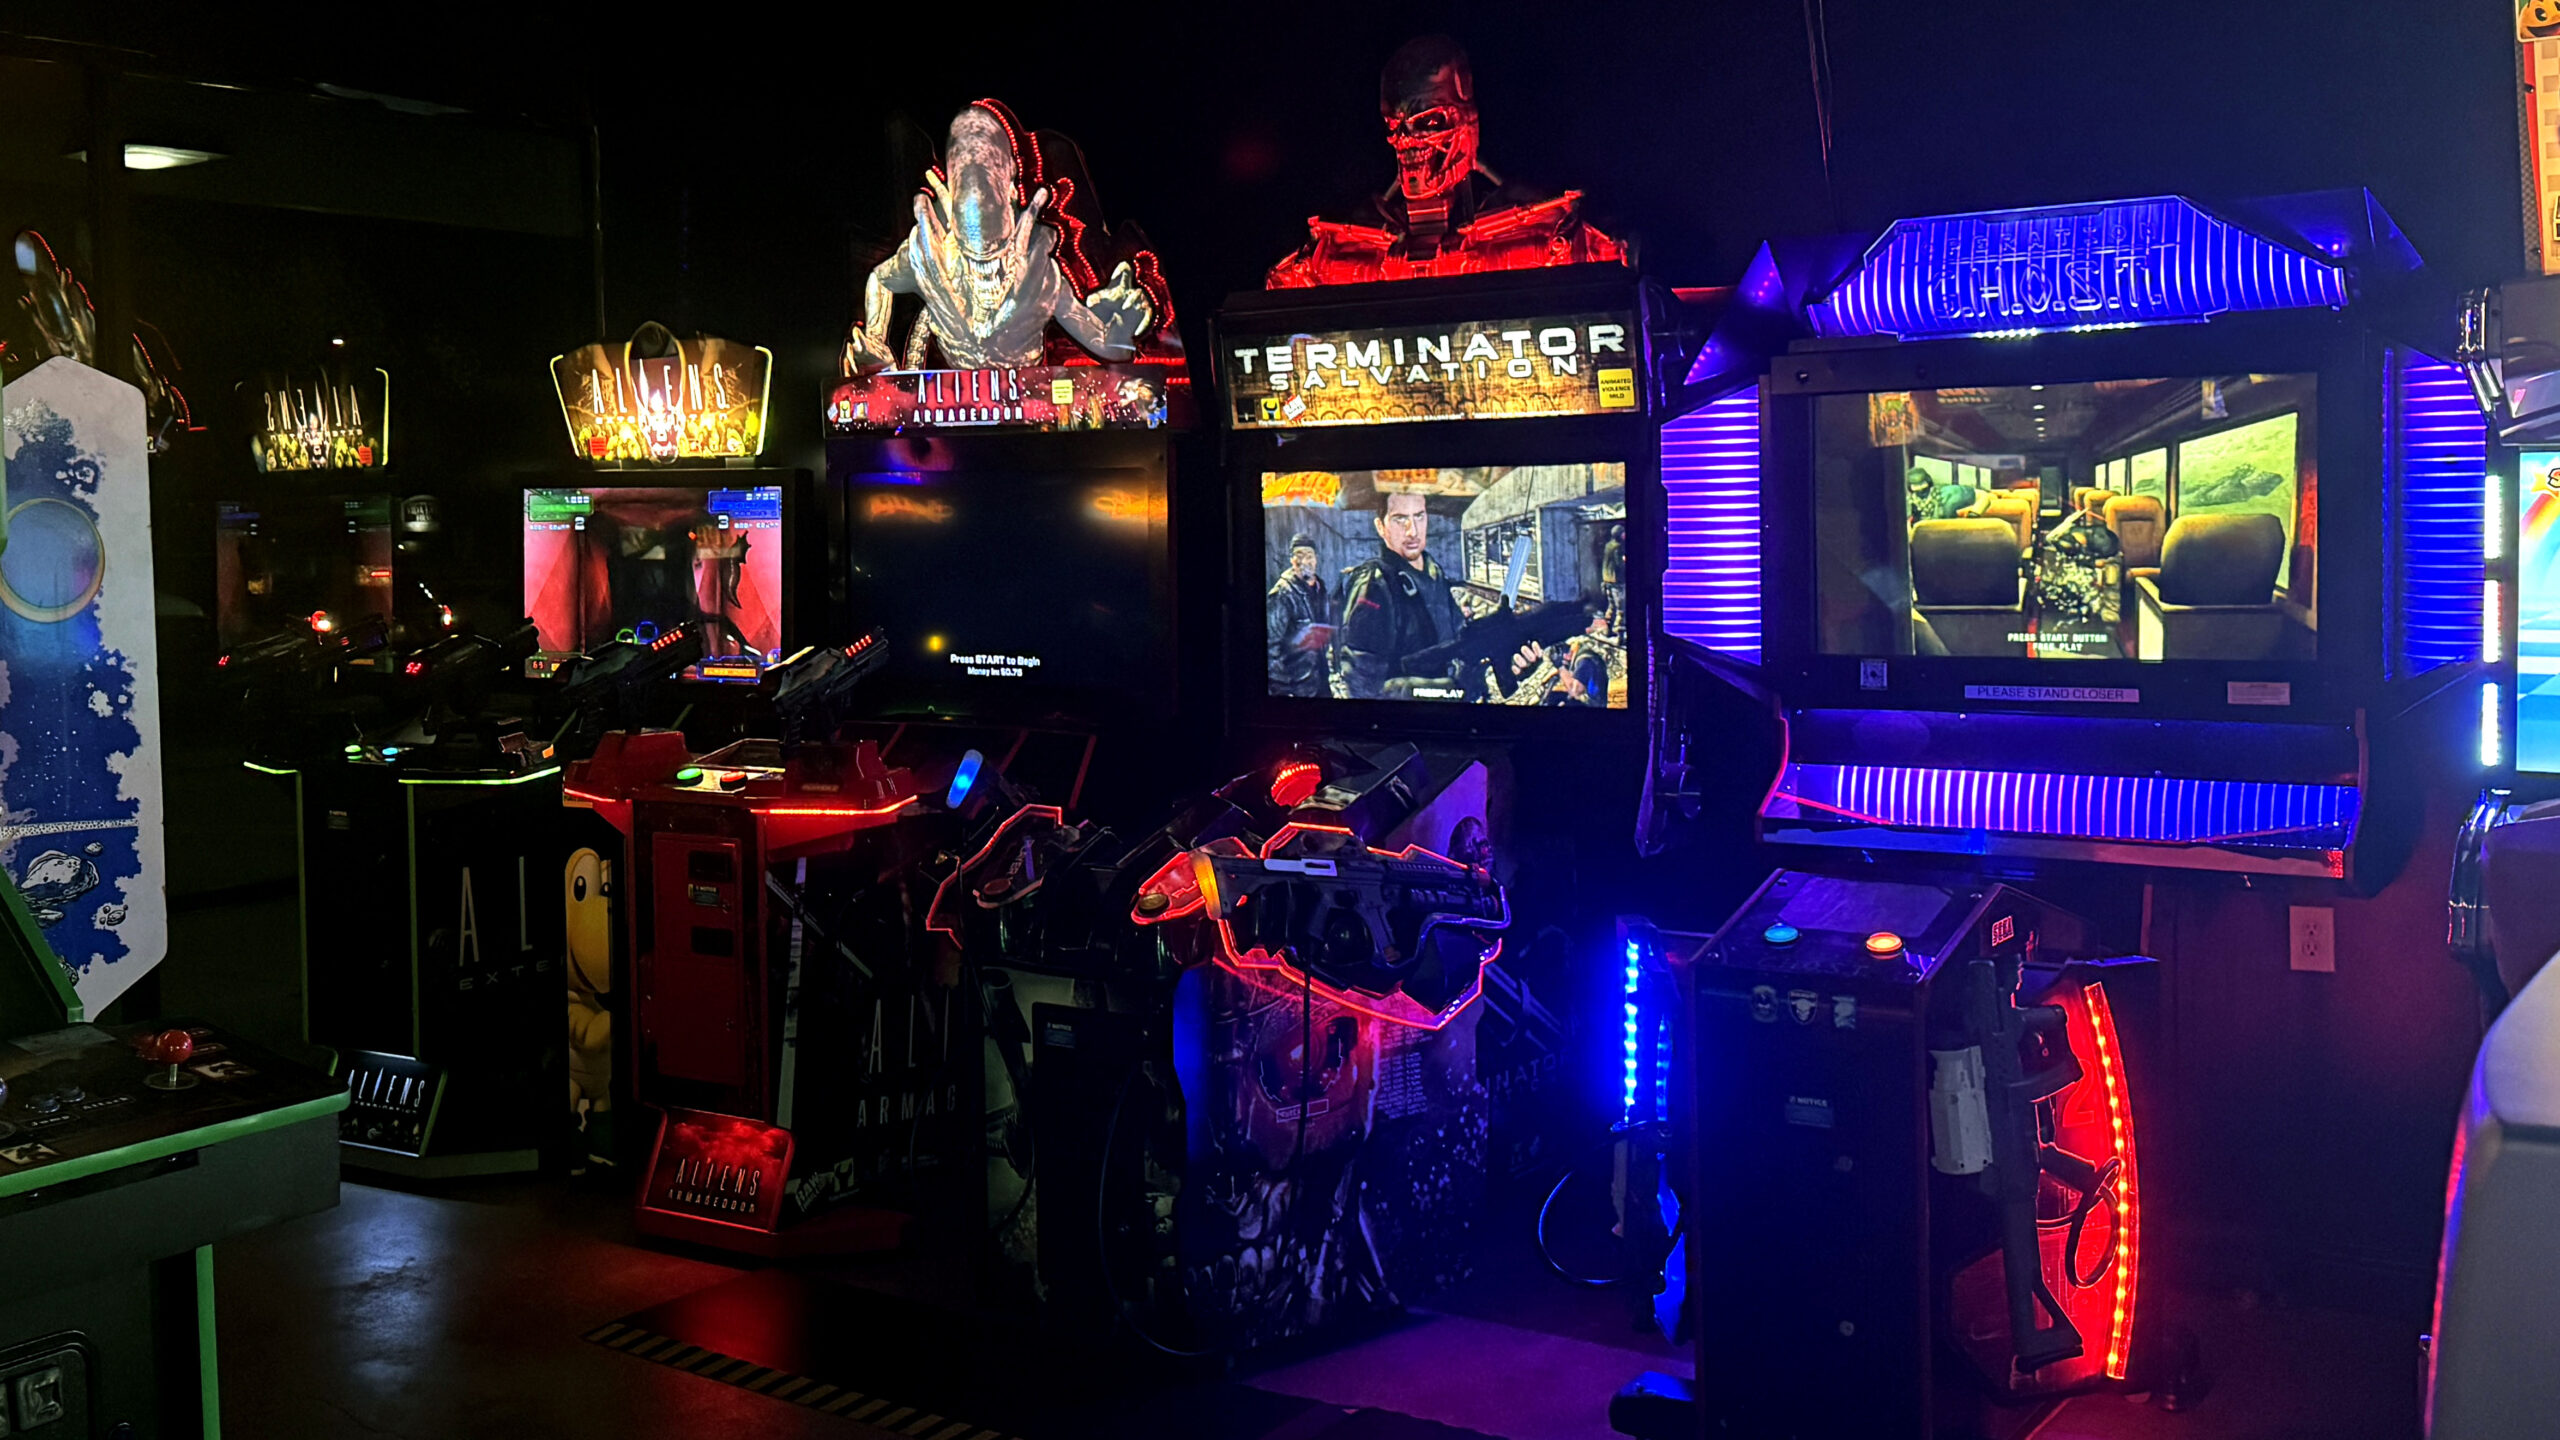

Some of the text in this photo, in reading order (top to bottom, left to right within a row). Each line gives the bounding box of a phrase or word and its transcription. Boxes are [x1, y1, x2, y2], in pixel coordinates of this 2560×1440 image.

[1234, 324, 1626, 375] TERMINATOR
[592, 358, 730, 414] ALIENS
[1269, 355, 1578, 391] SALVATION
[917, 369, 1019, 404] ALIENS
[913, 406, 1023, 423] ARMAGEDDON
[2007, 632, 2108, 643] PRESS START BUTTON
[2032, 642, 2083, 651] FREE PLAY
[950, 653, 1041, 668] Press START to Begin
[1977, 686, 2124, 700] PLEASE STAND CLOSER
[675, 1157, 760, 1197] ALIENS
